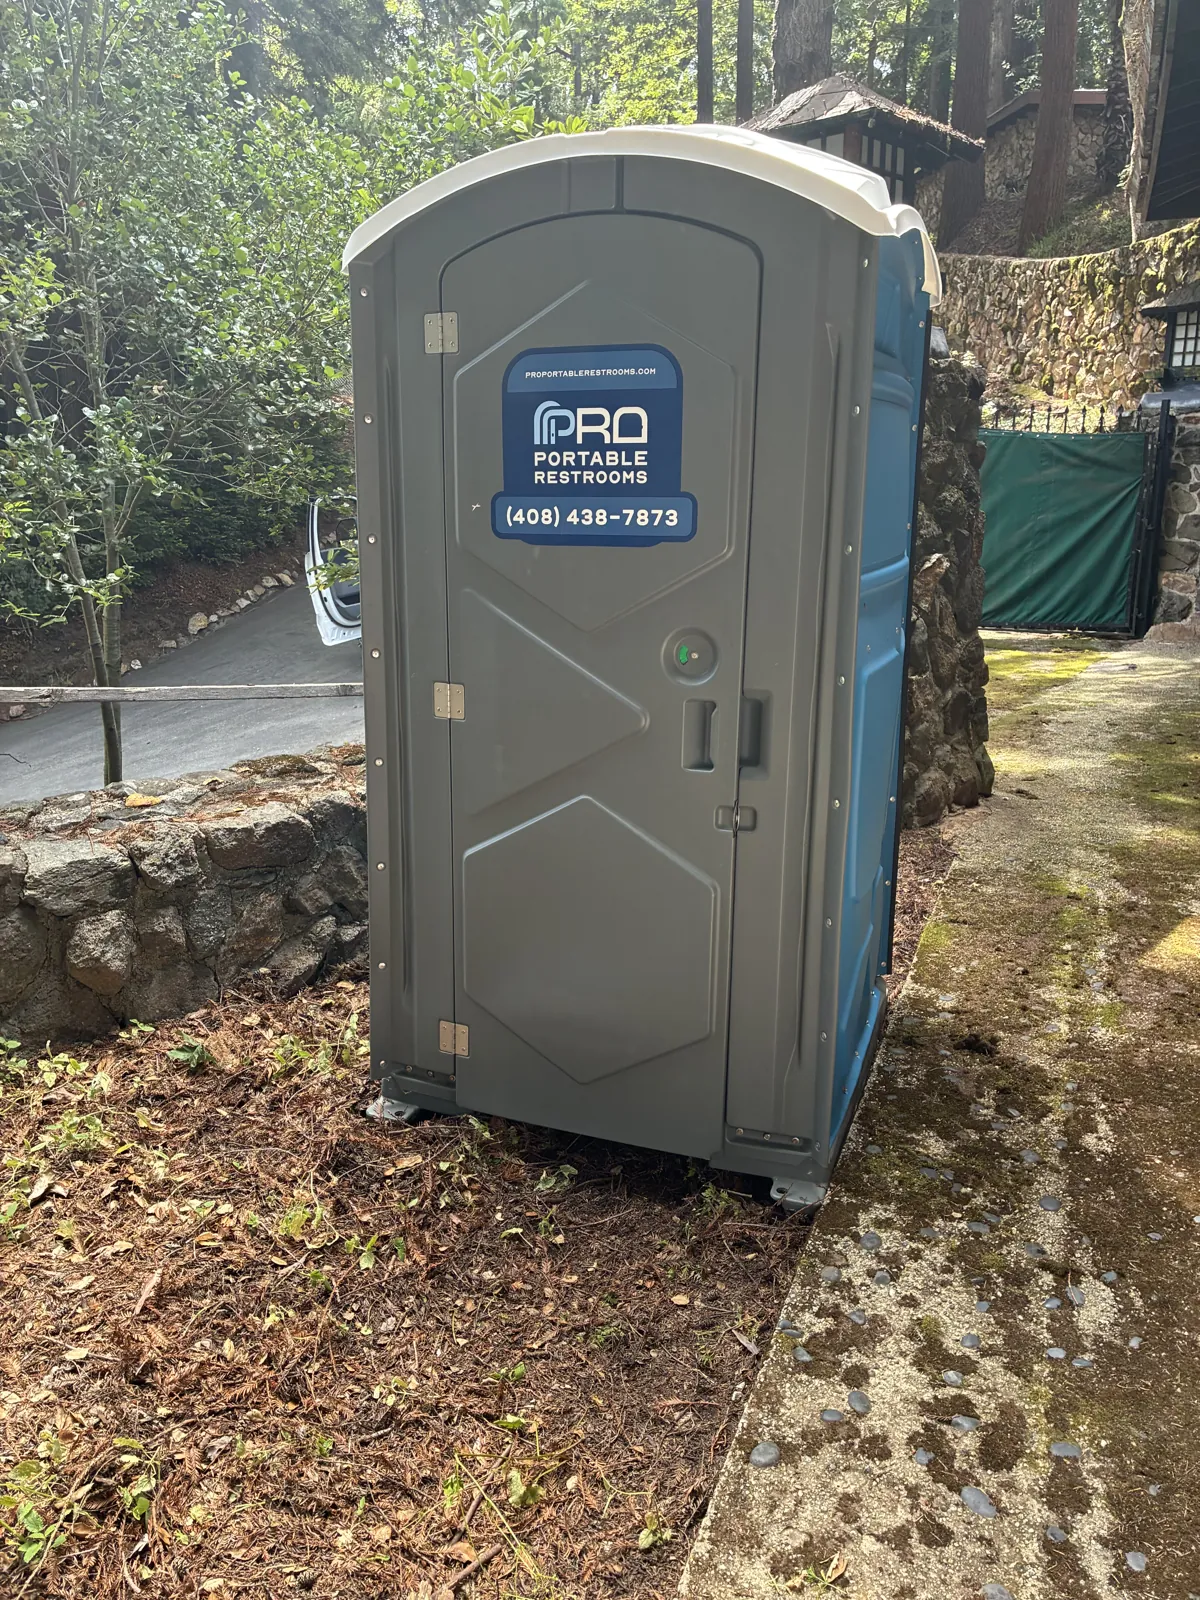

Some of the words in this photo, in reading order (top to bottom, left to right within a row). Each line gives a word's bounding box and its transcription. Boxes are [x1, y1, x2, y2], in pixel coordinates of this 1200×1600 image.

[525, 368, 656, 379] PROPORTABLERESTROOMS.COM
[533, 400, 649, 445] PRO
[534, 450, 648, 467] PORTABLE
[534, 470, 648, 484] RESTROOMS
[506, 505, 560, 528] (408)
[566, 508, 679, 527] 438-7873
